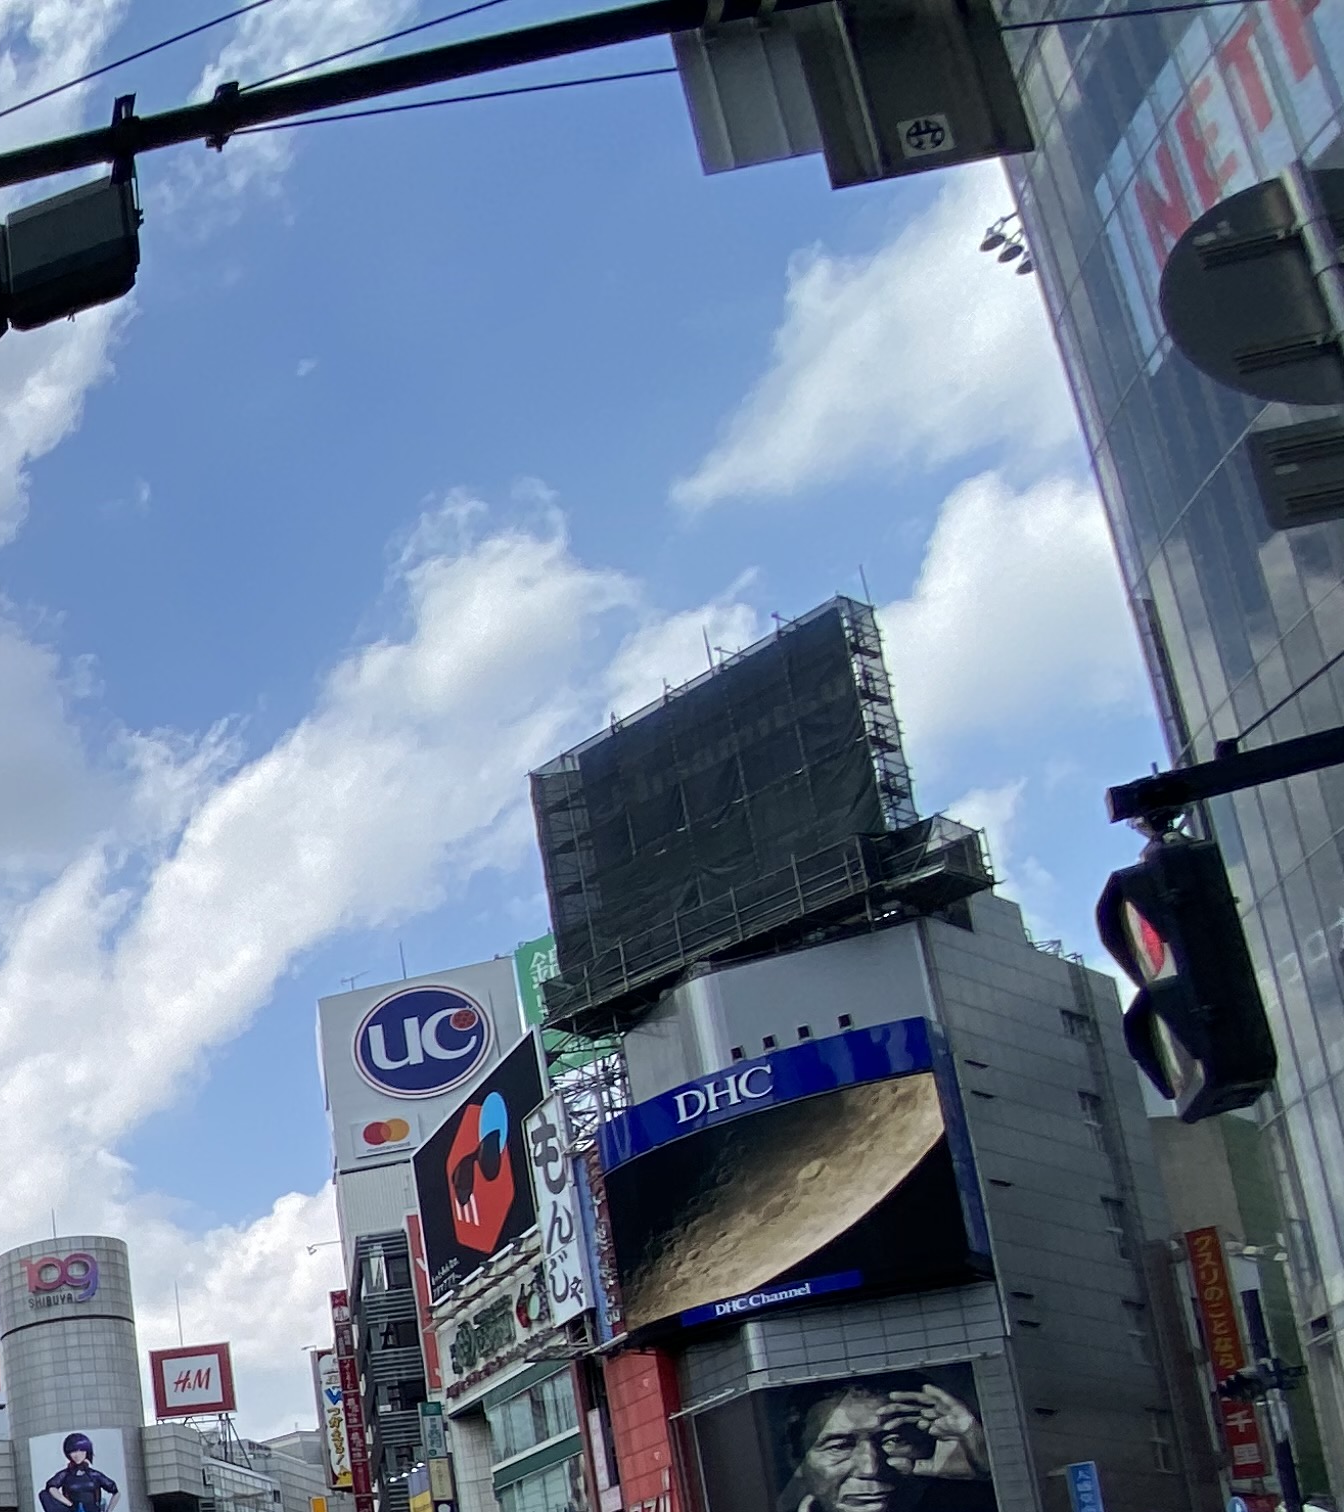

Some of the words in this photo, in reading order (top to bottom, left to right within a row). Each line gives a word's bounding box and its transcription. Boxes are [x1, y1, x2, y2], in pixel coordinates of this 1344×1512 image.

[366, 1008, 478, 1070] UC
[672, 1066, 774, 1124] DHC
[531, 1112, 585, 1304] もんじゃ
[21, 1253, 100, 1300] 109
[28, 1293, 73, 1309] SHIBUYA
[714, 1299, 747, 1317] DHC
[749, 1284, 812, 1308] Channel
[1193, 1234, 1237, 1370] クスリのことなら
[173, 1367, 211, 1393] H&M
[1226, 1409, 1263, 1466] 千里
